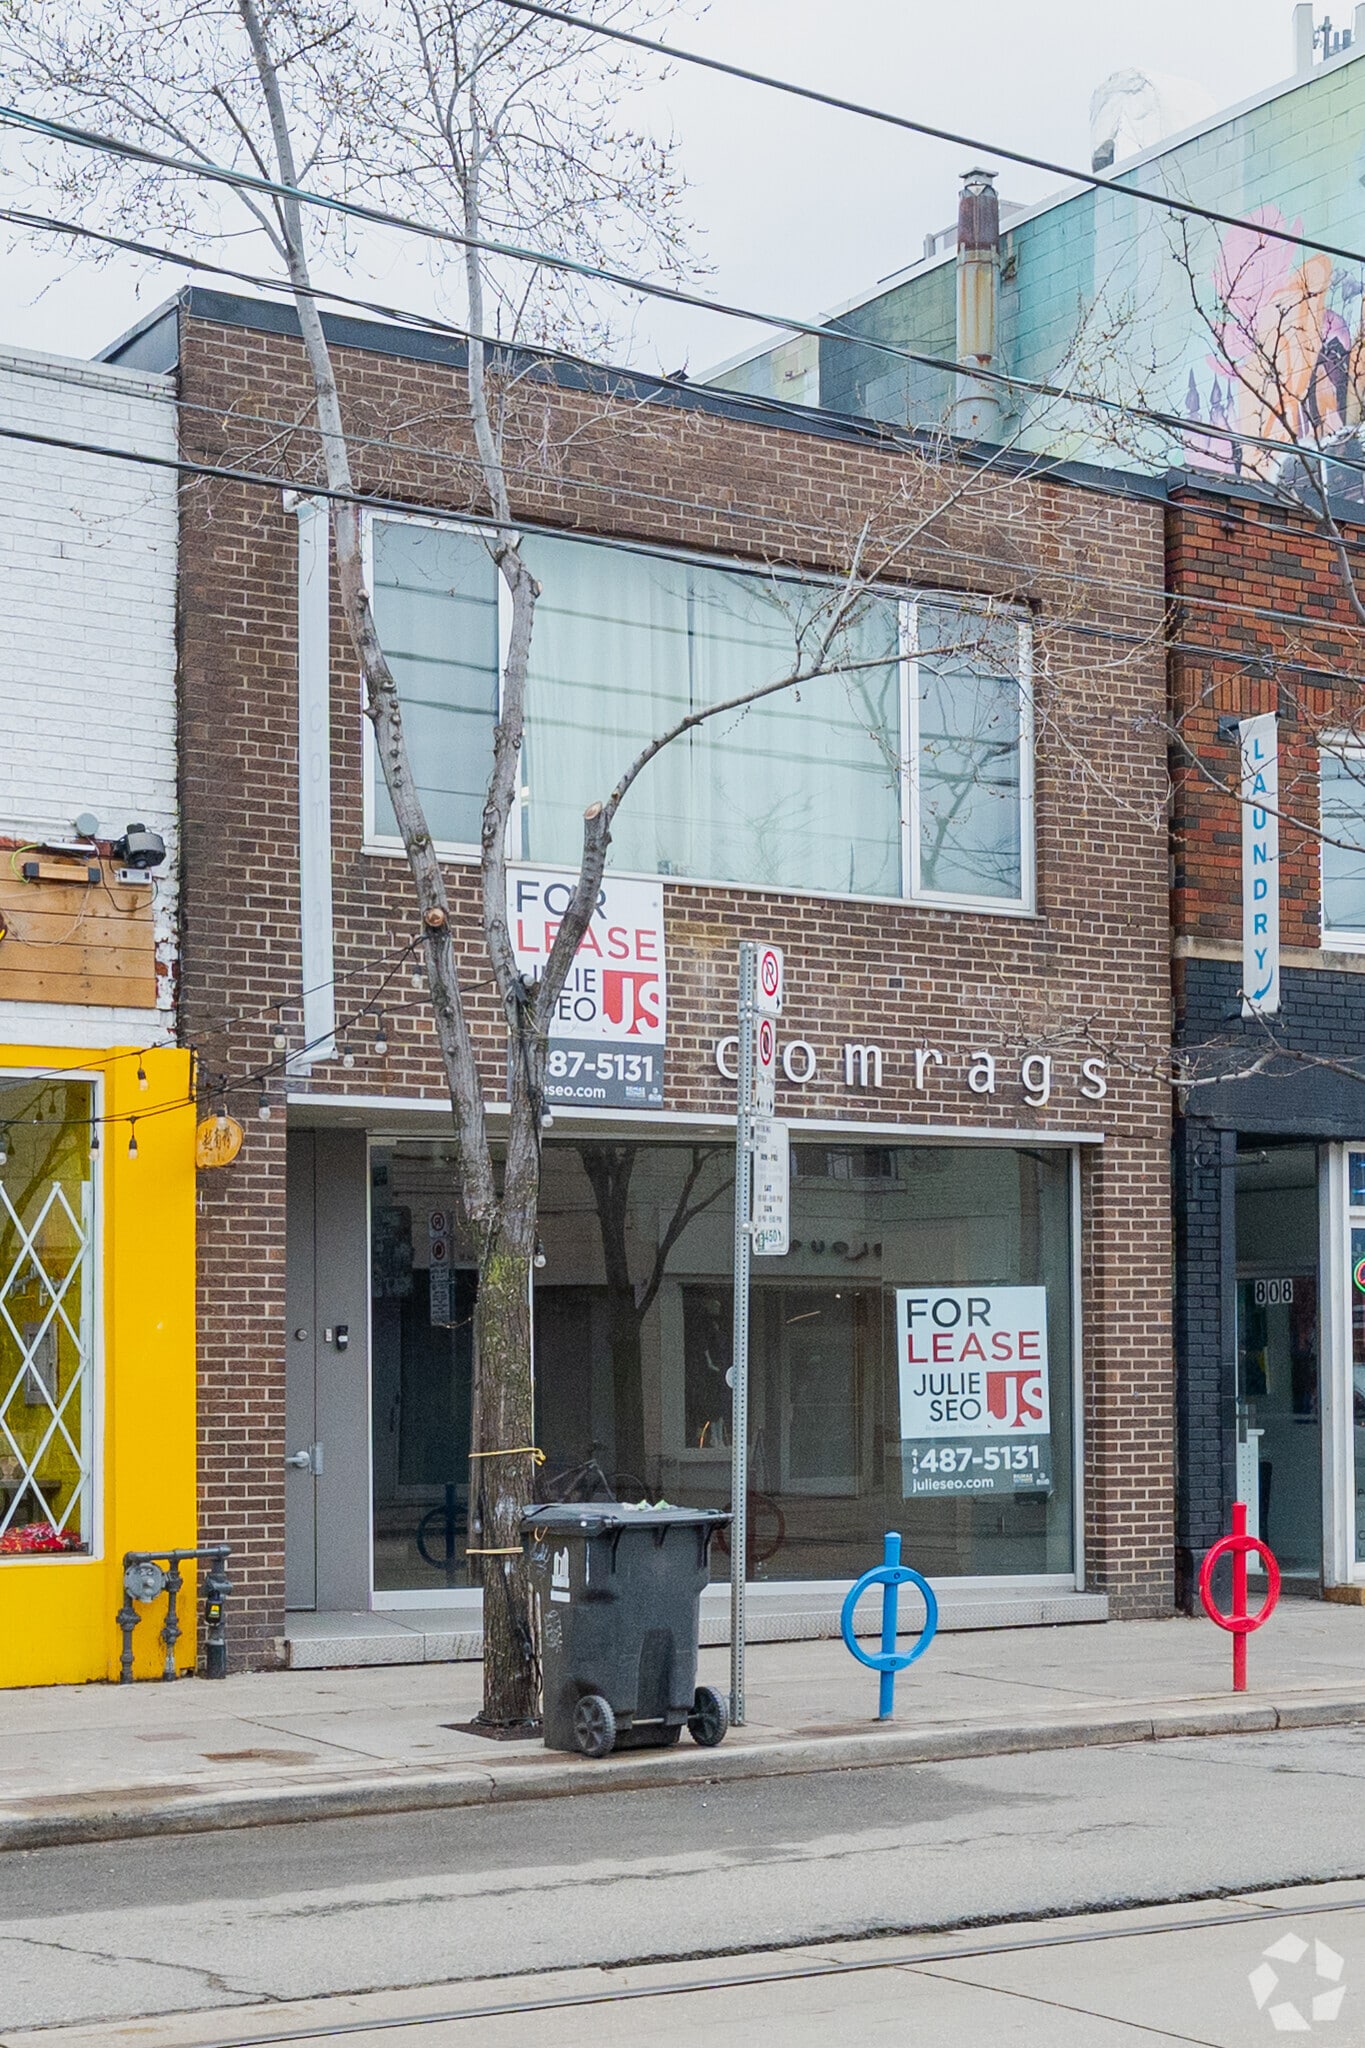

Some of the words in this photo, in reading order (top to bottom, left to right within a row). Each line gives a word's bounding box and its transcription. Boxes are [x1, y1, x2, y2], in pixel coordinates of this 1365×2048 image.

[1252, 738, 1268, 970] LAUNDRY
[517, 919, 658, 962] LEASE
[558, 995, 597, 1022] EO
[547, 1050, 653, 1083] 87-5131
[716, 1036, 1108, 1107] comrags
[1256, 1280, 1292, 1301] 808
[906, 1297, 992, 1328] FOR
[907, 1331, 1041, 1363] LEASE
[913, 1372, 981, 1396] JULIE
[929, 1398, 981, 1422] SEO
[920, 1445, 1039, 1473] 487-5131
[912, 1477, 994, 1493] julieseo.com
